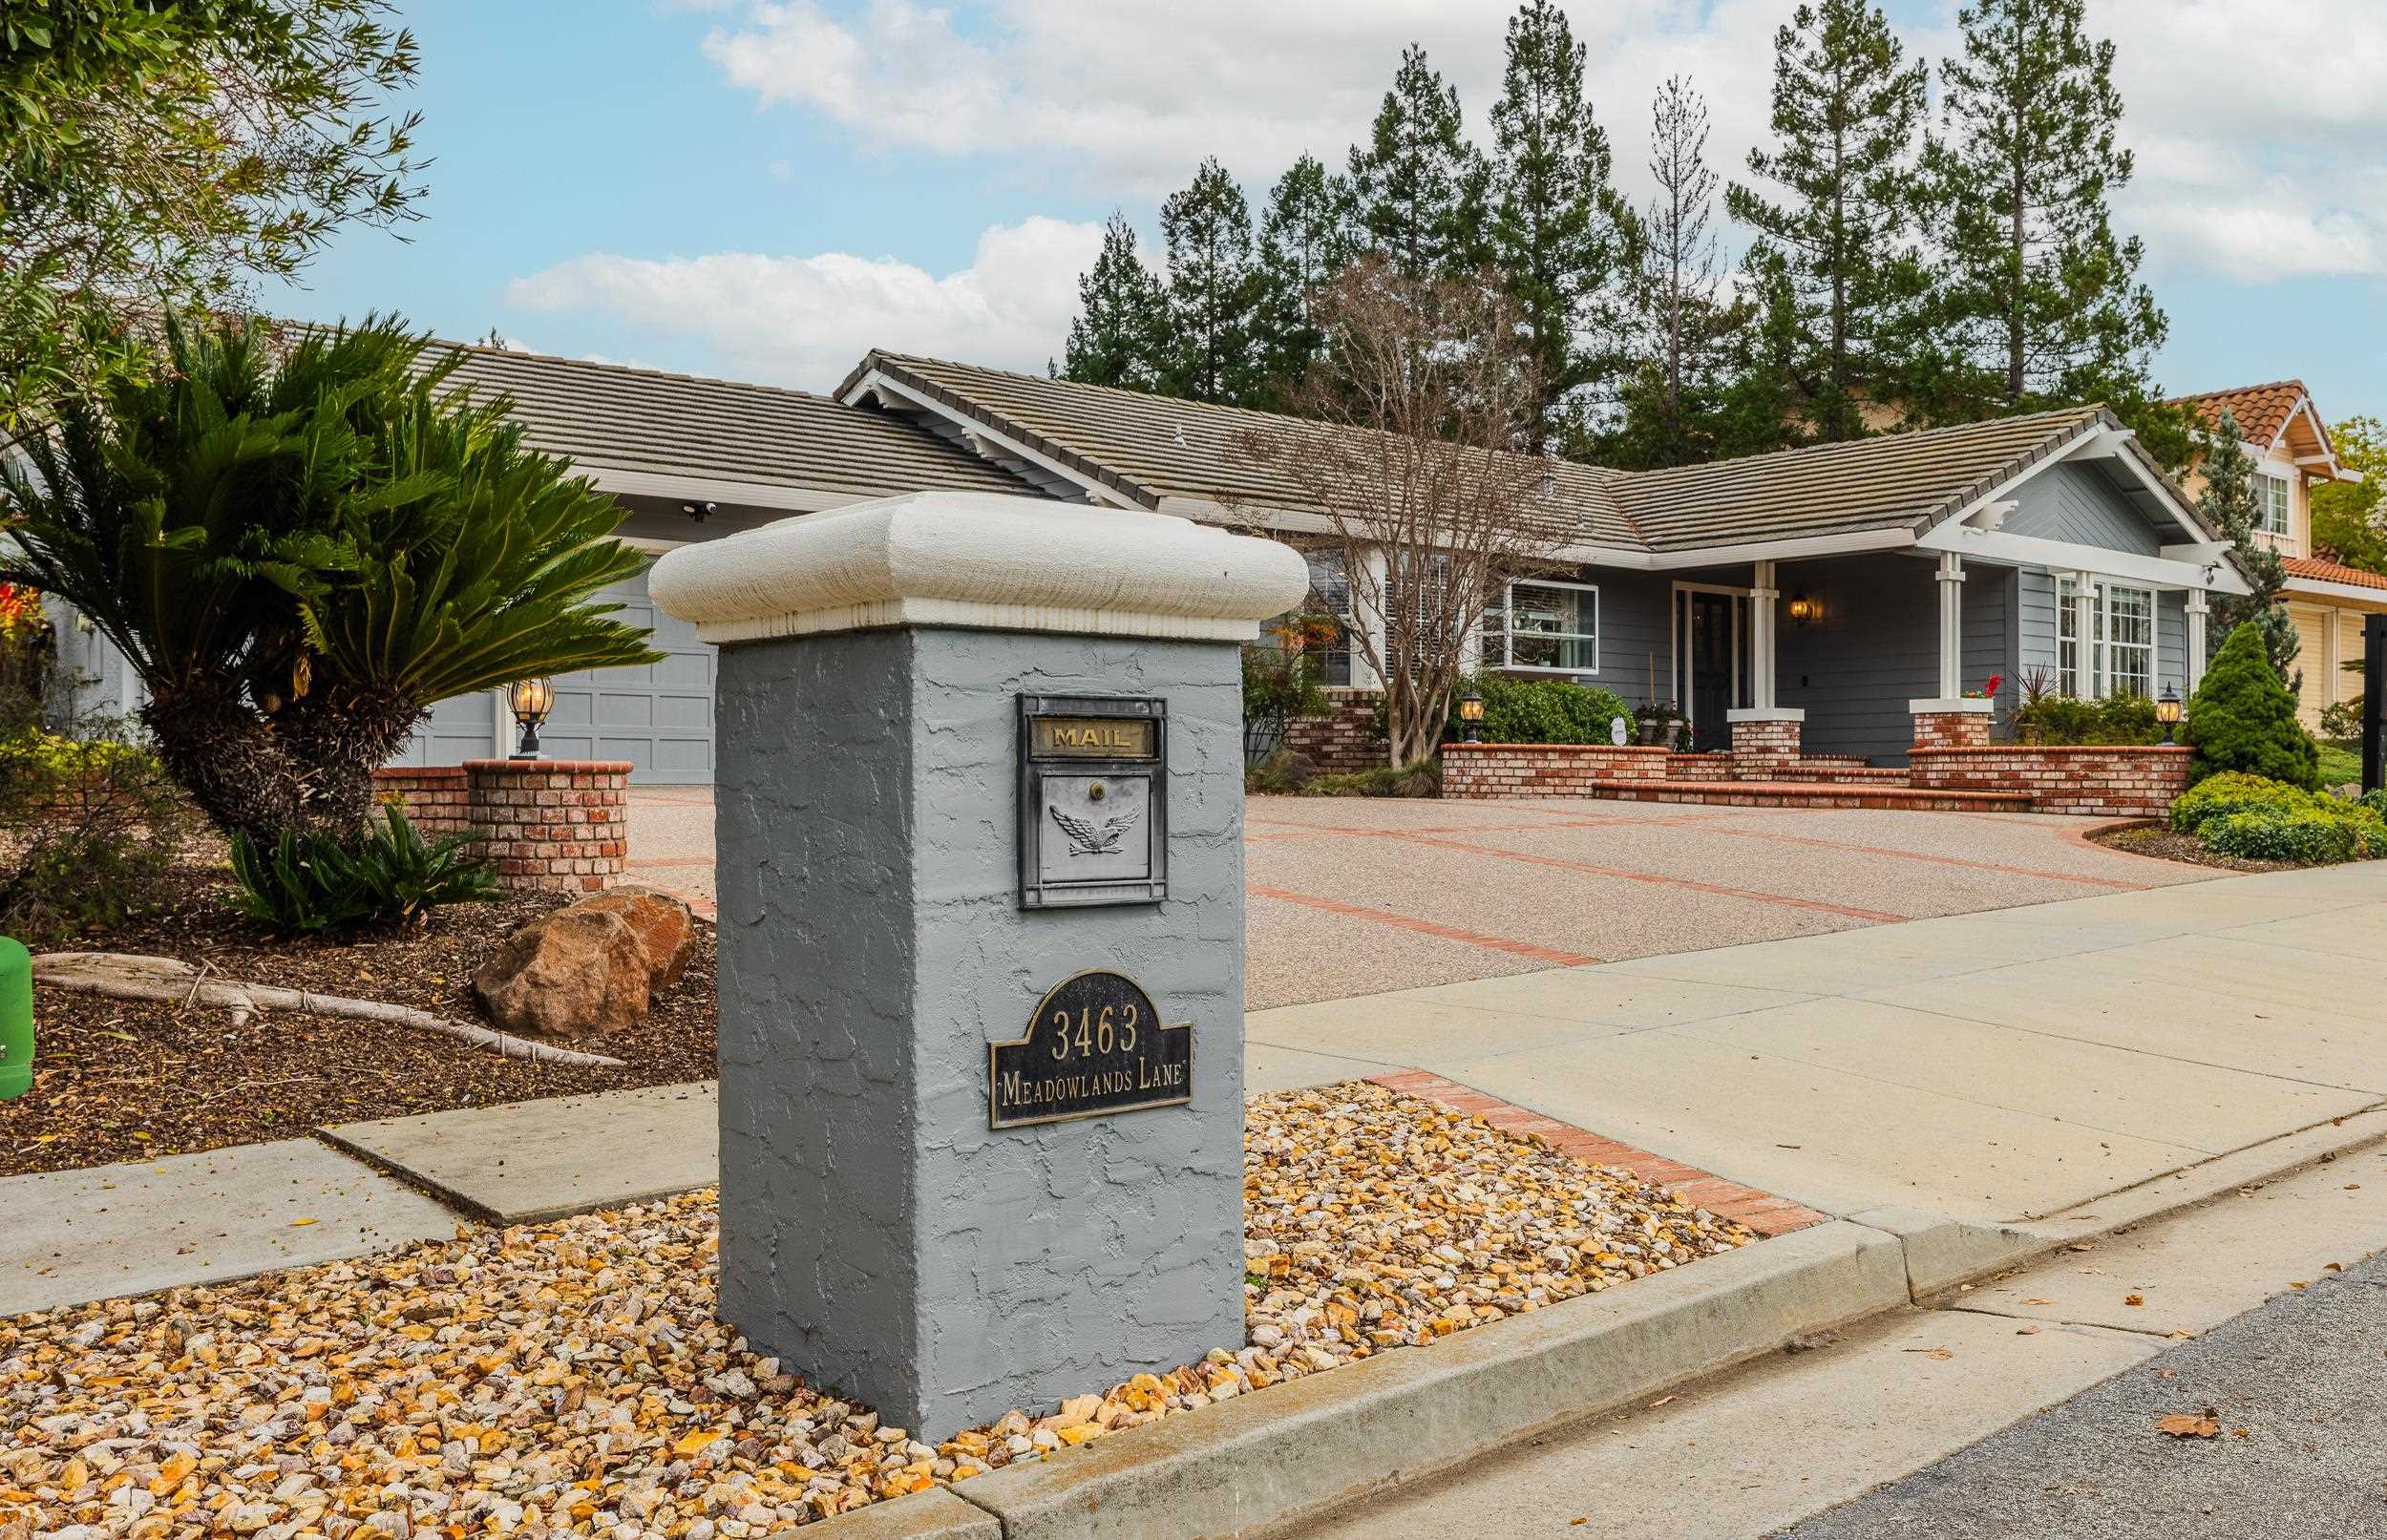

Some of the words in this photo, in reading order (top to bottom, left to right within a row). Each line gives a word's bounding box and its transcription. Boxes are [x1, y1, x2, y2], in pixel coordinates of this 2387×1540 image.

[1052, 728, 1131, 747] MAIL
[1052, 1004, 1138, 1061] 3463
[1002, 1070, 1132, 1107] MEADOWLANDS
[1139, 1057, 1182, 1089] LANE
